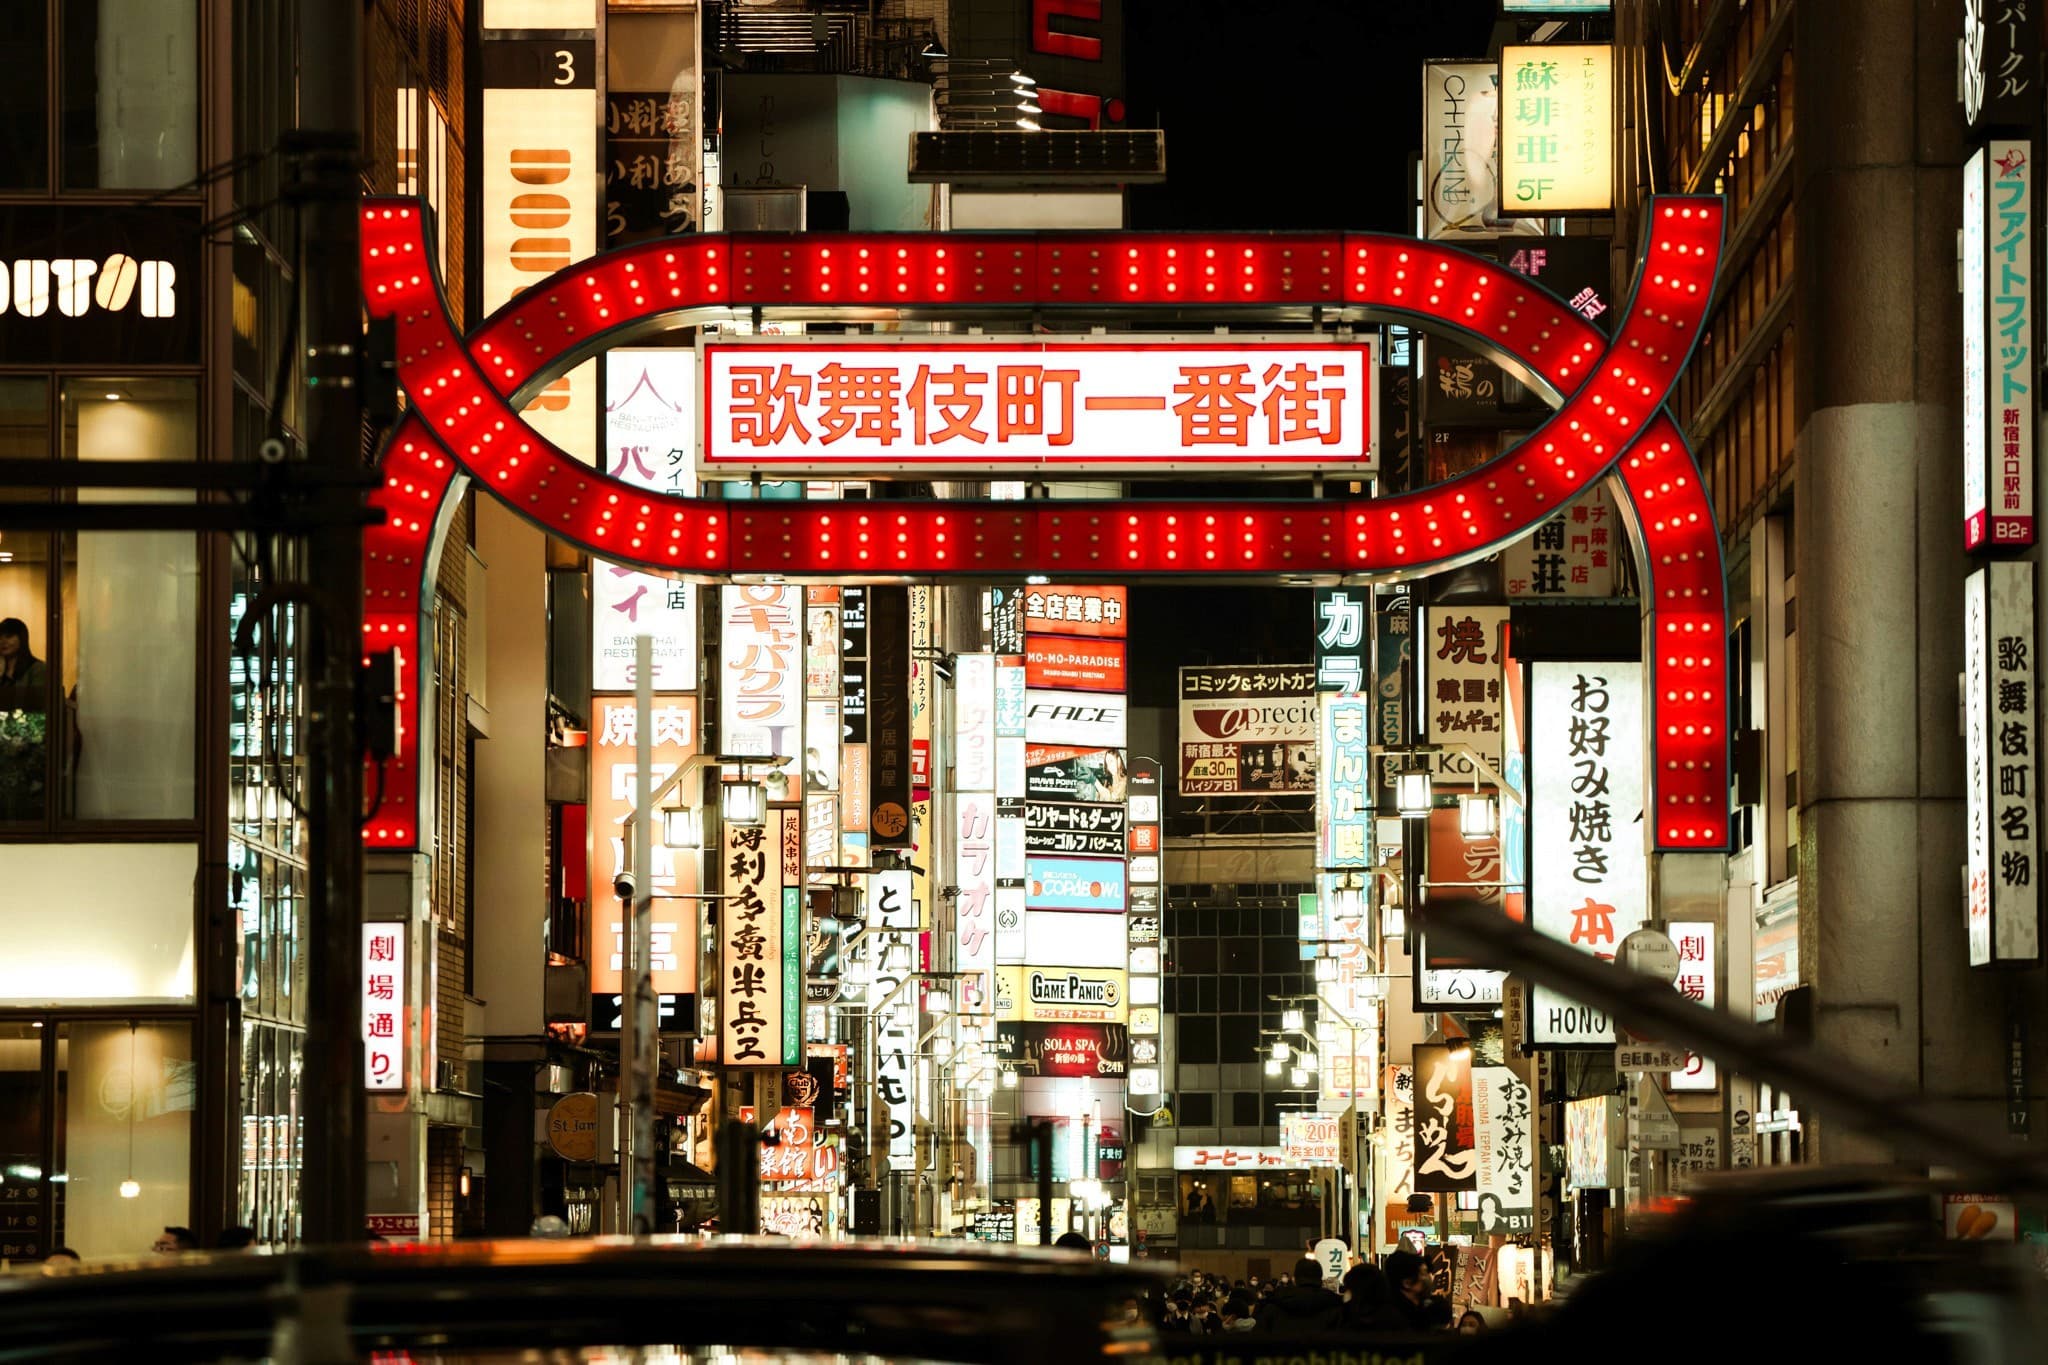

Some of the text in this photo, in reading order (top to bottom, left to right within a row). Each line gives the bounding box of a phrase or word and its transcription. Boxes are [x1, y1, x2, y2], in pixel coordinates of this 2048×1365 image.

[553, 50, 575, 86] 3
[1516, 179, 1555, 202] 5F
[1509, 249, 1546, 275] 4F
[0, 252, 176, 318] UTOR
[1994, 180, 2028, 404] ファイトフィット
[729, 361, 1346, 448] 歌舞伎町一番街
[1434, 432, 1450, 443] 2F
[2003, 408, 2020, 509] 新宿東口駅前
[1996, 523, 2028, 539] B2F
[1508, 580, 1528, 595] 3F
[1026, 592, 1121, 625] 全店営業中
[1436, 614, 1499, 665] 焼
[603, 648, 685, 659] RESTRANT
[1027, 652, 1121, 668] MO-MO-PARADISE
[1010, 668, 1025, 737] カラオケ
[1027, 704, 1123, 734] FACE
[1254, 726, 1315, 737] アプレシ
[1185, 743, 1239, 759] 新宿最大
[1997, 635, 2030, 887] 歌舞伎町名物
[1185, 779, 1240, 793] ハイジアB1
[1568, 673, 1613, 884] お好み焼き
[1002, 798, 1014, 807] 2F
[1026, 805, 1123, 831] ビリヤード&ダーツ
[783, 816, 800, 877] 炭火串焼
[960, 802, 991, 957] カラオケ
[1002, 879, 1014, 888] 1F
[1032, 974, 1104, 1001] GAME PANIC
[368, 935, 395, 1076] 劇場通り
[1679, 935, 1705, 1076] 劇場り
[1044, 1038, 1096, 1052] SOLA SPA
[1620, 1051, 1680, 1067] 自転車を除く
[1477, 1078, 1490, 1126] HIROSHIMA
[573, 1119, 598, 1132] Jam
[2011, 1111, 2026, 1125] 17
[1495, 1077, 1533, 1195] お好み焼き
[1193, 1149, 1253, 1167] コーヒー
